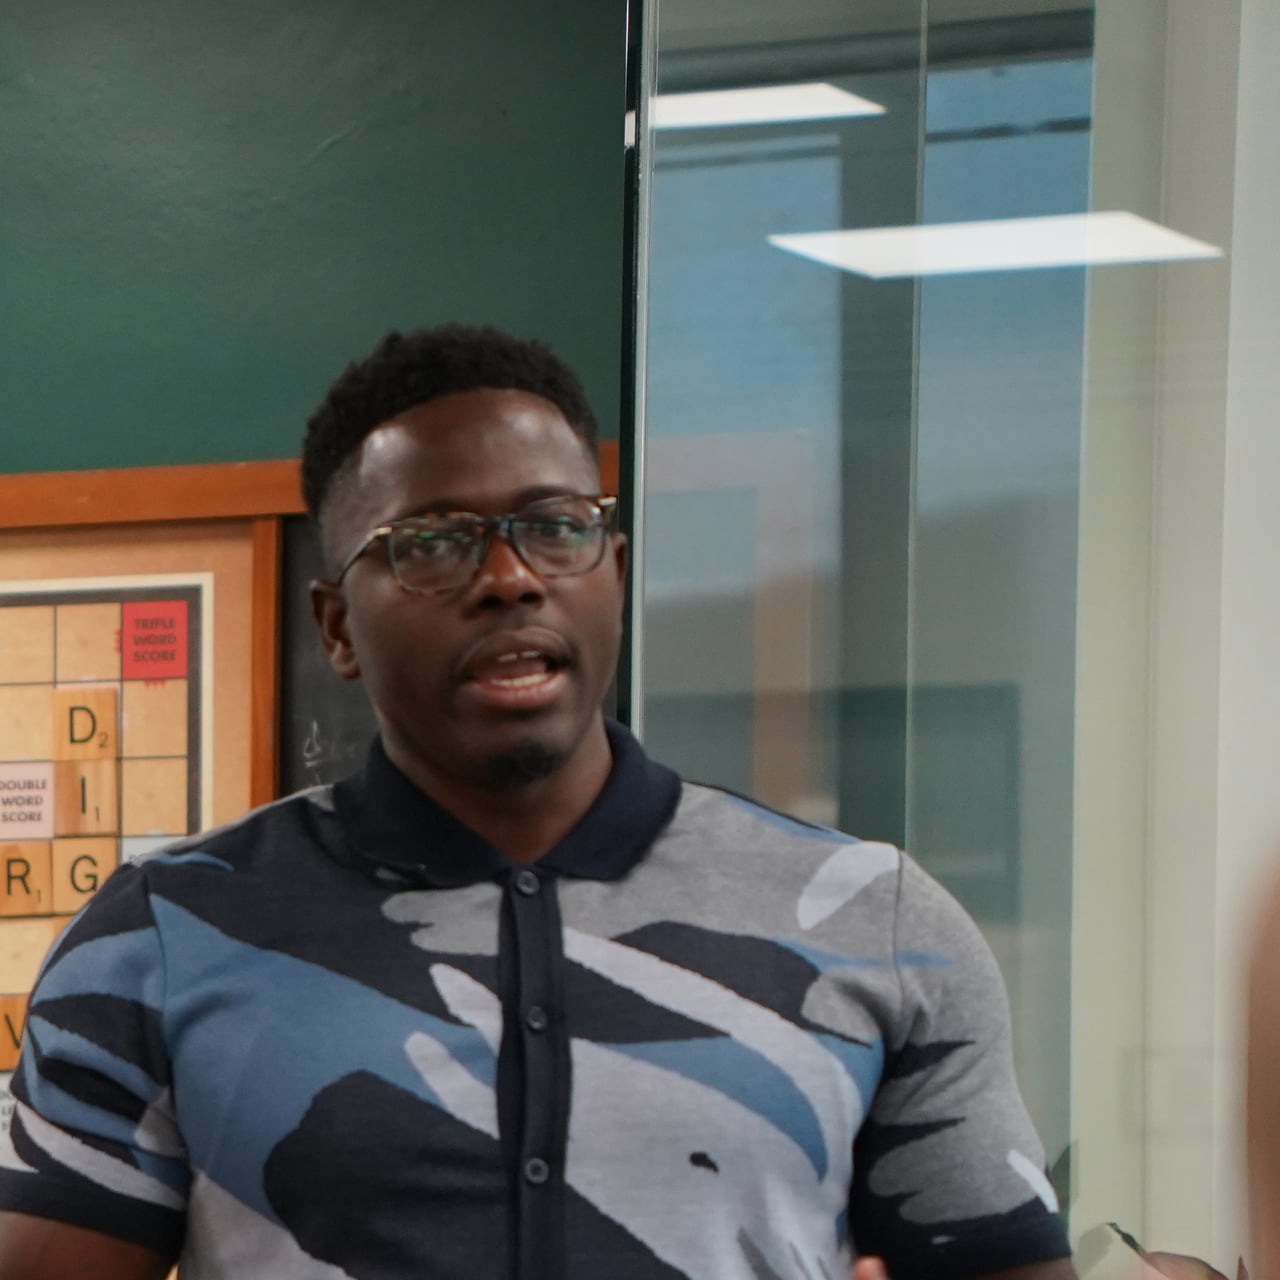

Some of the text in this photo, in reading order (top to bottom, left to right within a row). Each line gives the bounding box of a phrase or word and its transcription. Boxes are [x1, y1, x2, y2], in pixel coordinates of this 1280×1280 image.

[134, 617, 175, 630] TRIPLE
[132, 633, 176, 646] WORD
[133, 650, 176, 663] SCORE
[0, 795, 43, 807] WORD
[1, 811, 43, 823] SCORE
